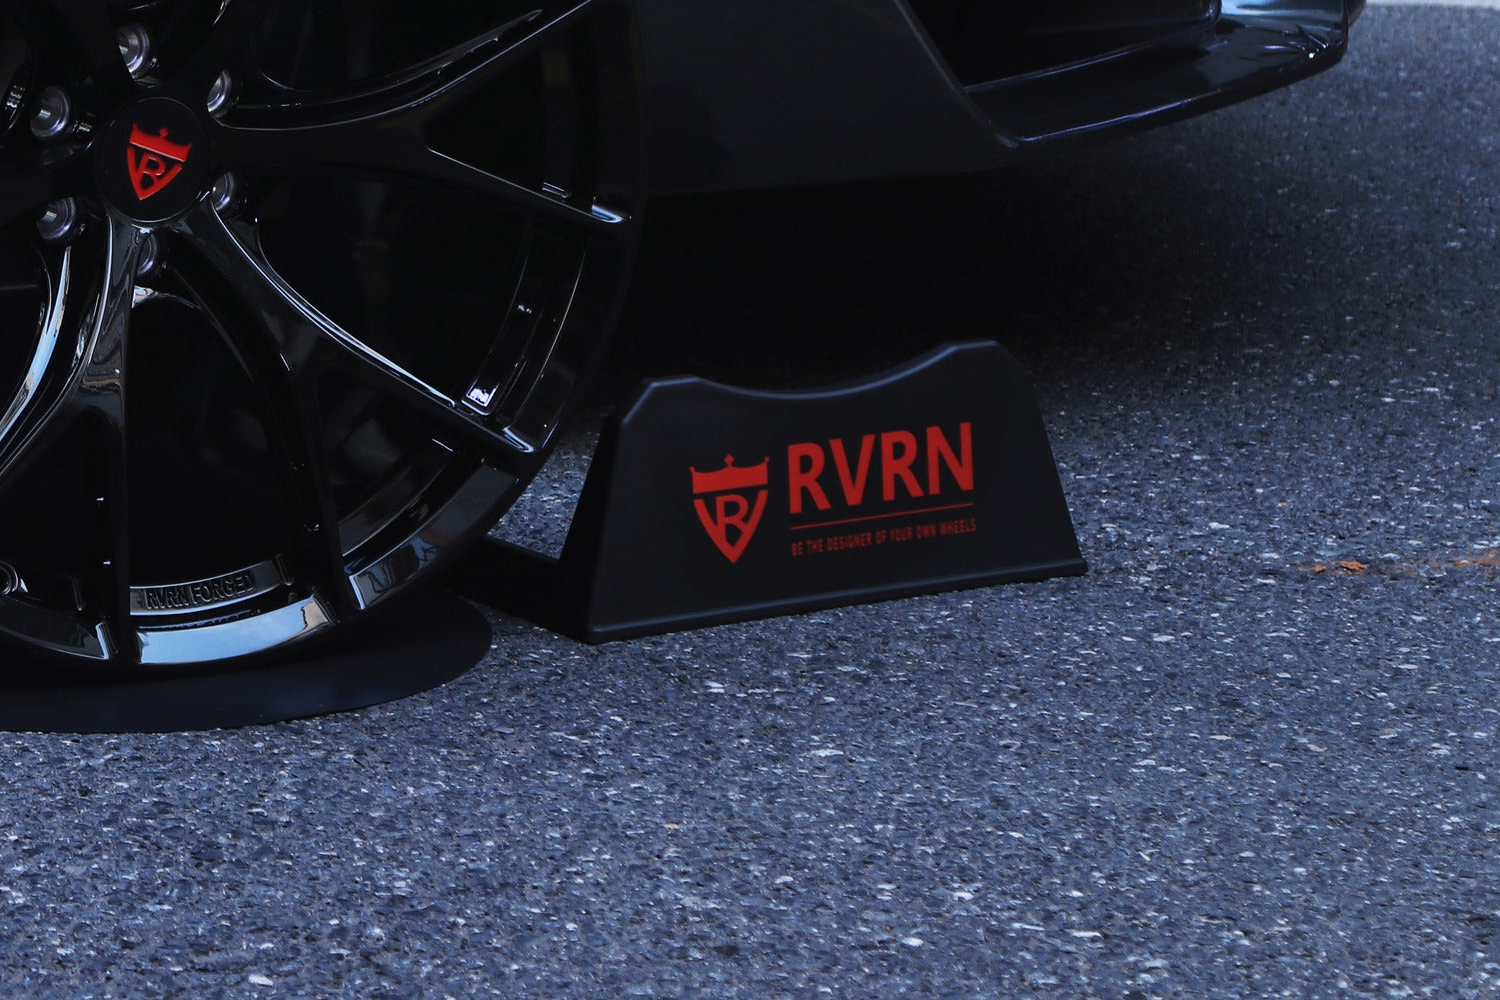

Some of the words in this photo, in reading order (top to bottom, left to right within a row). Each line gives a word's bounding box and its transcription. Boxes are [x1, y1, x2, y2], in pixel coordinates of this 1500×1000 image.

[788, 421, 975, 514] RVRN
[791, 541, 804, 557] BE
[806, 537, 825, 554] THE
[827, 532, 872, 552] DESIGNER
[875, 529, 888, 545] OF
[890, 526, 914, 543] YOUR
[916, 523, 937, 539] OWN
[940, 518, 977, 535] WHEELS
[189, 572, 256, 605] FORGED
